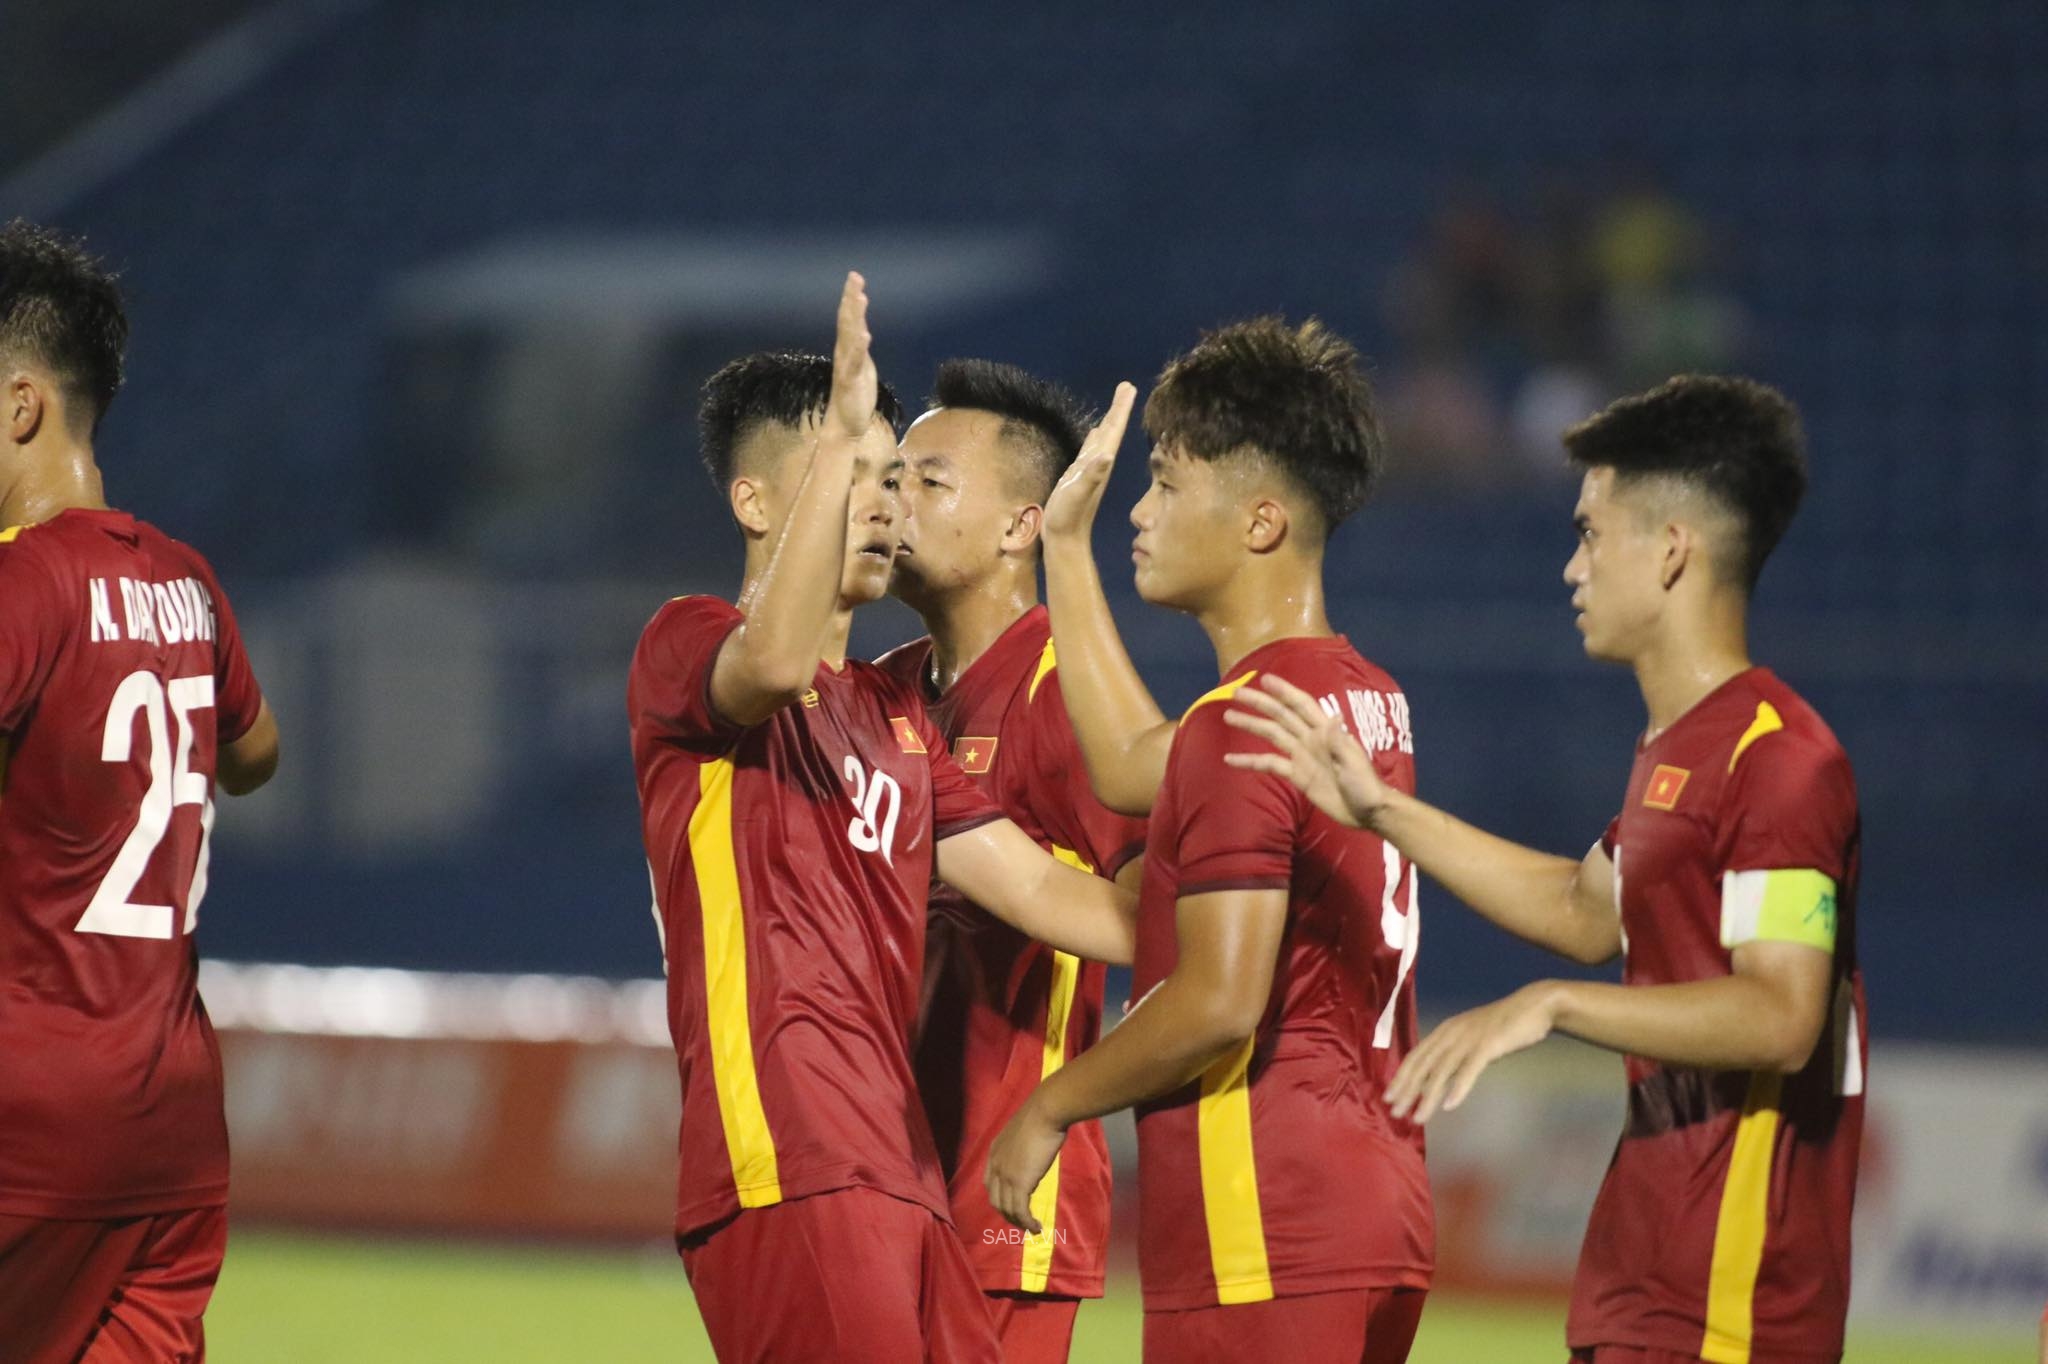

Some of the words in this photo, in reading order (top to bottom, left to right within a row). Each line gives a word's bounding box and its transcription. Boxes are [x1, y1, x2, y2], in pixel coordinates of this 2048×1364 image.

[90, 578, 120, 642] N.
[74, 670, 215, 939] 25
[844, 755, 900, 869] 30
[1372, 839, 1420, 1049] 9
